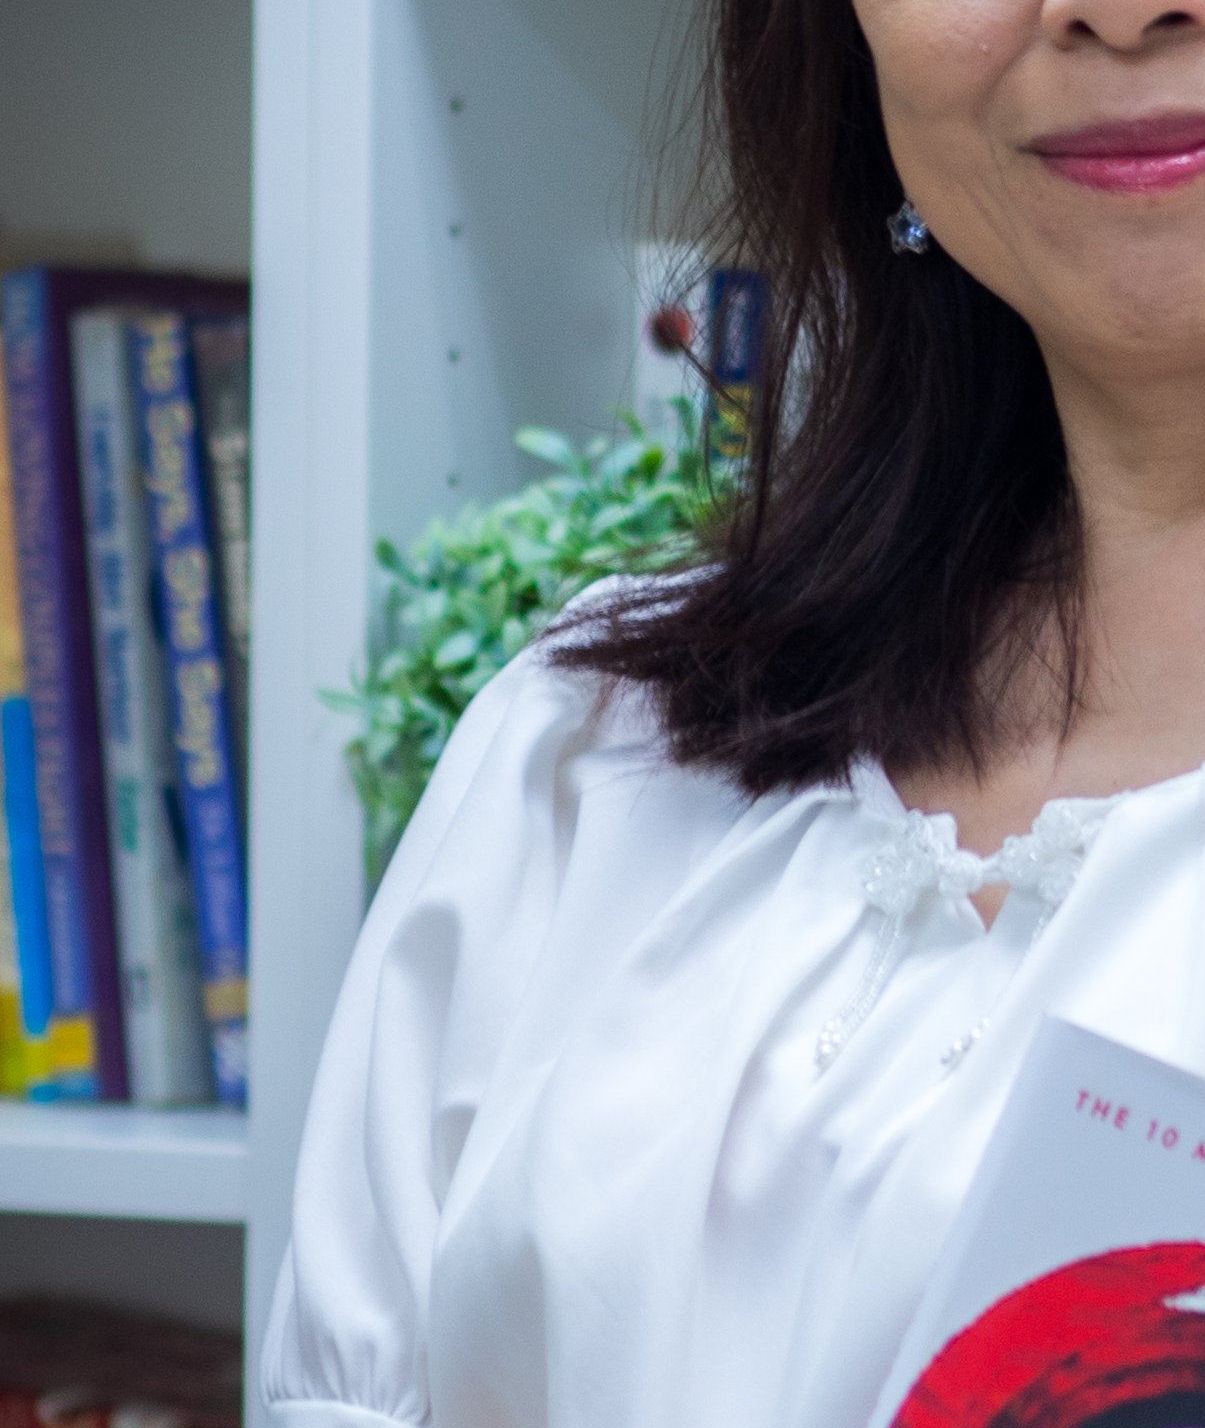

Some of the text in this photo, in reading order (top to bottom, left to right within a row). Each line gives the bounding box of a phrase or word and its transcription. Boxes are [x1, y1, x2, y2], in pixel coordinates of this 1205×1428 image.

[143, 398, 194, 543] Says,
[161, 545, 211, 651] She
[175, 656, 225, 788] Says
[1076, 1089, 1130, 1131] THE
[1146, 1119, 1180, 1150] 10
